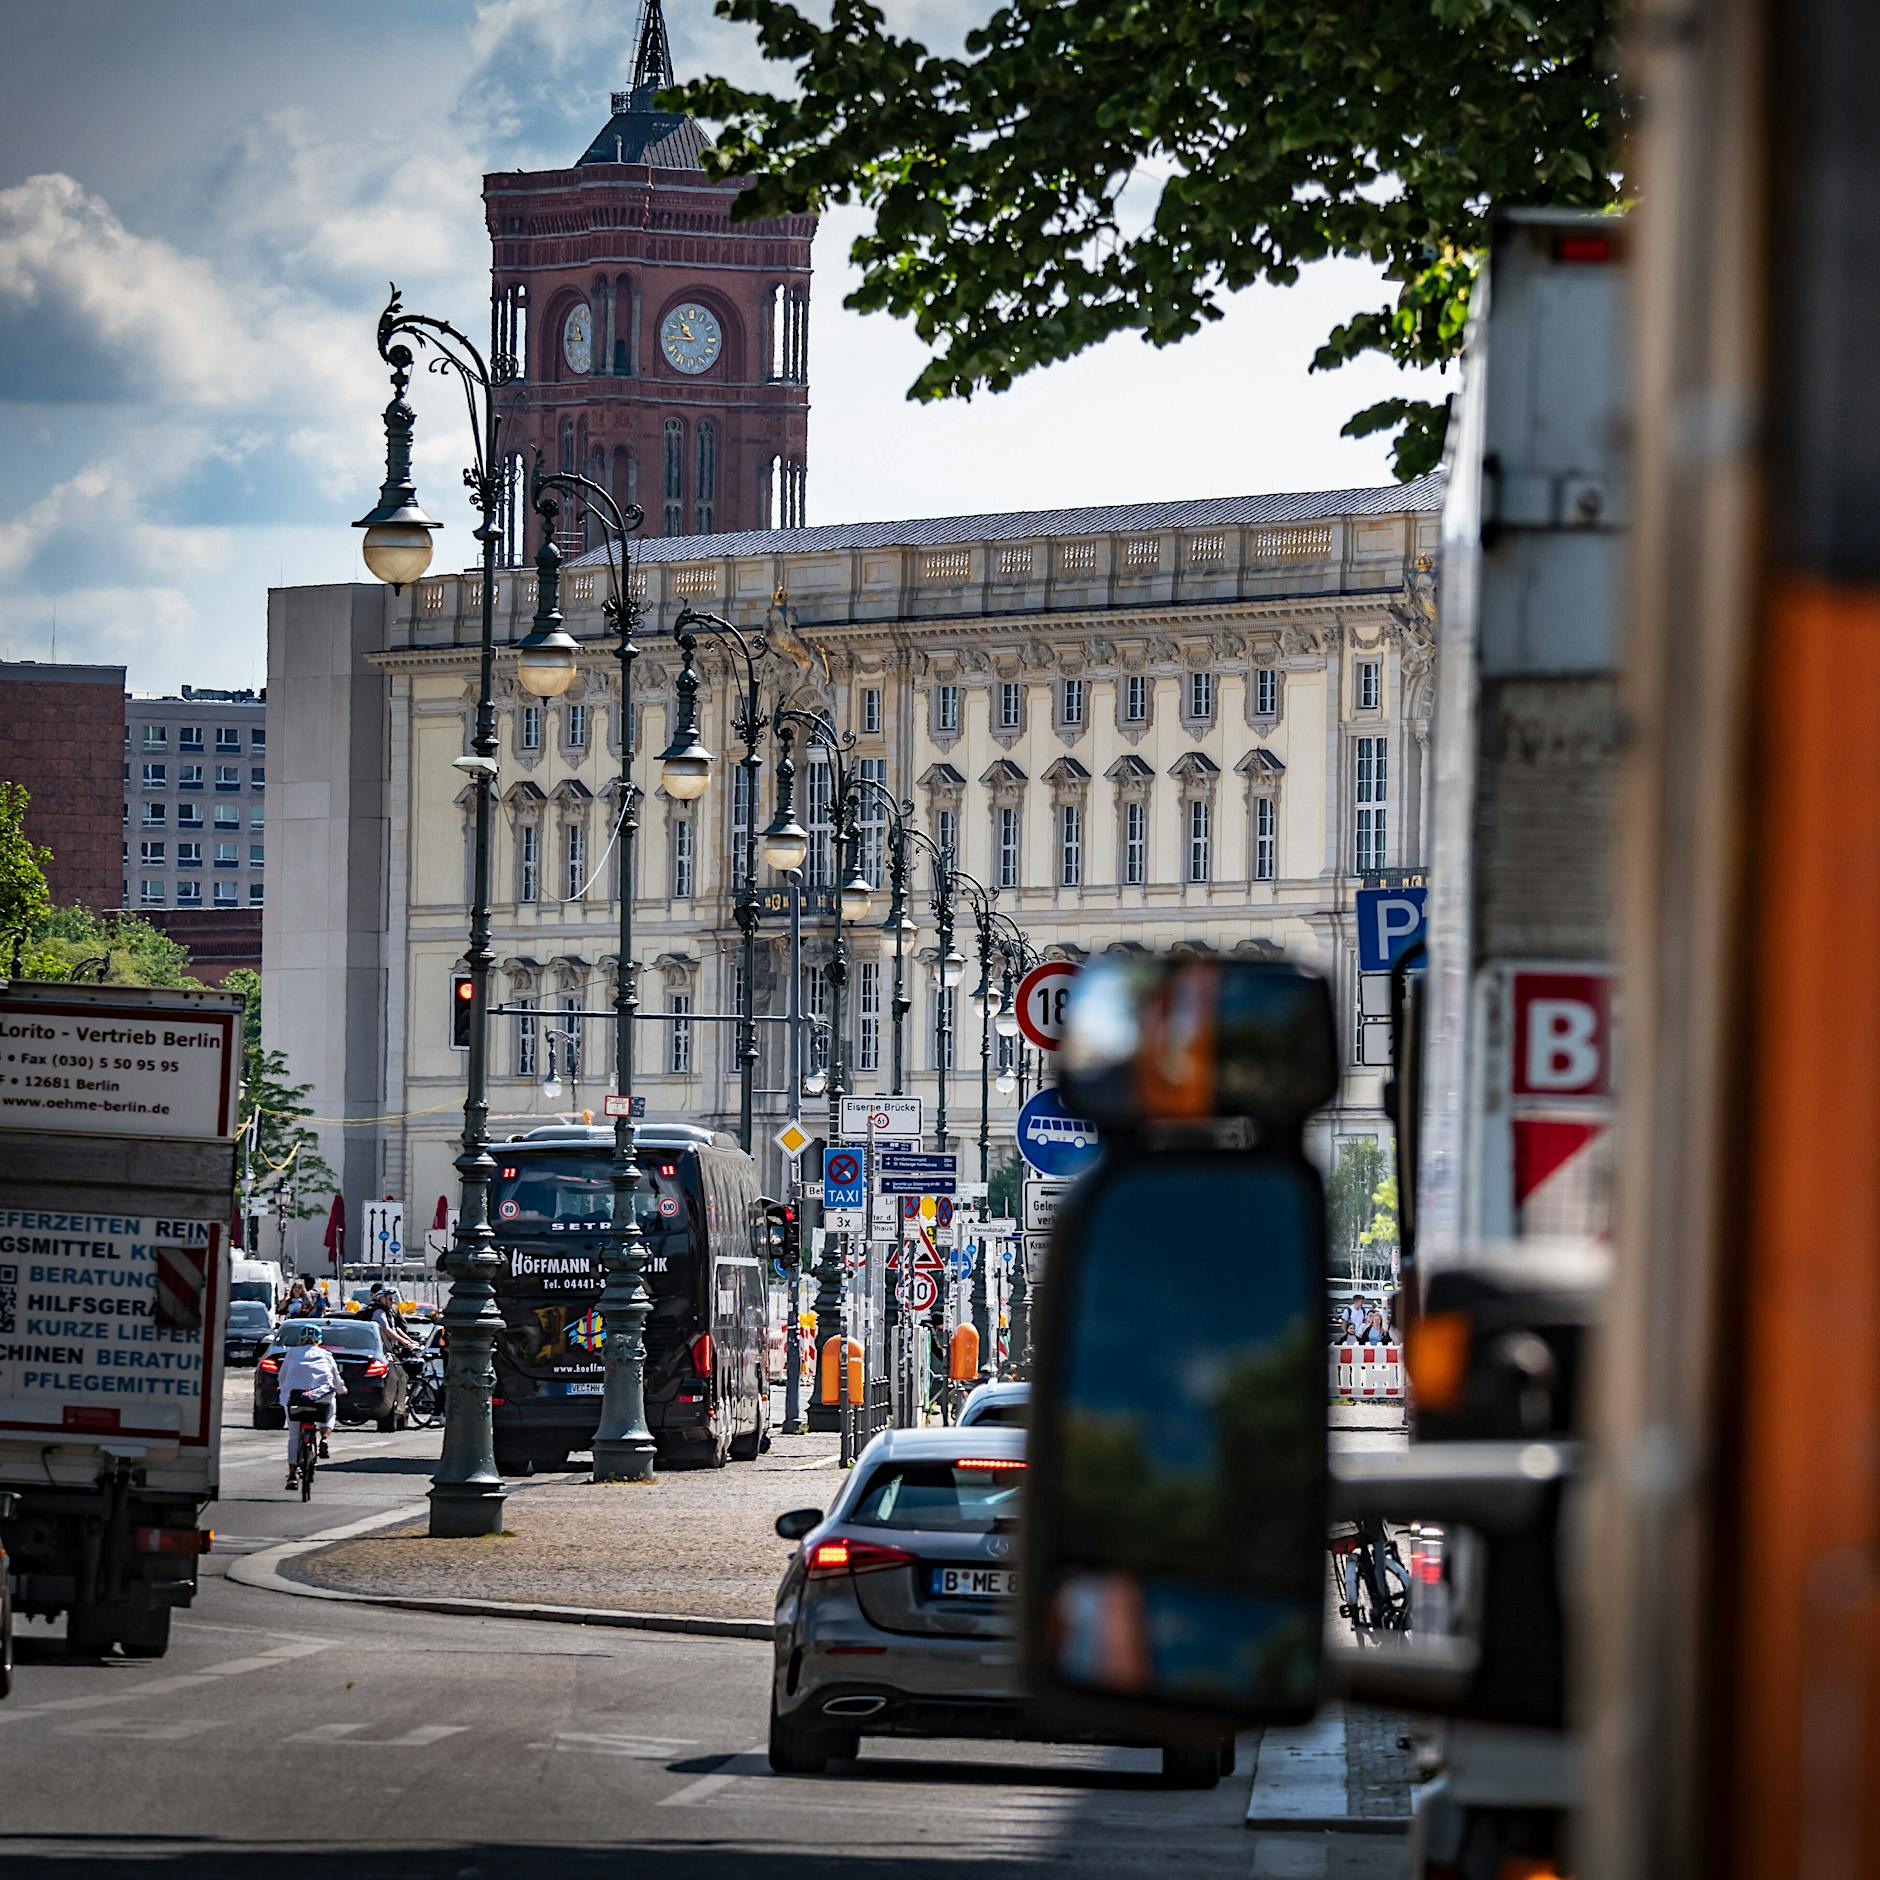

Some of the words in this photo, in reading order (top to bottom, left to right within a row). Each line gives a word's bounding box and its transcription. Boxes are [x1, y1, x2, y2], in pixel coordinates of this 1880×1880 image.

[1376, 899, 1420, 960] P
[1037, 987, 1070, 1025] 18
[0, 1022, 55, 1040] Lorito
[76, 1026, 157, 1045] Vertrieb
[163, 1031, 220, 1049] Berlin
[1526, 999, 1600, 1090] B
[21, 1053, 47, 1065] Fax
[52, 1054, 93, 1070] (030)
[100, 1057, 108, 1068] 5
[113, 1057, 131, 1070] 50
[137, 1059, 155, 1072] 95
[161, 1060, 179, 1073] 95
[25, 1076, 70, 1089] 12681
[76, 1078, 119, 1091] Berlin
[2, 1097, 170, 1115] www.oehme-berlin.de
[884, 1103, 916, 1112] Brücke
[828, 1189, 859, 1203] TAXI
[662, 1203, 674, 1211] 100
[155, 1220, 208, 1239] REIN
[836, 1216, 851, 1228] 3x
[0, 1235, 120, 1260] GSMITTEL
[511, 1247, 590, 1277] HÖFFMANN
[543, 1279, 561, 1290] Tel.
[26, 1319, 109, 1339] KURZE
[117, 1324, 201, 1344] LIEFER
[23, 1371, 200, 1396] PFLEGEMITTEL
[945, 1571, 958, 1591] B
[972, 1571, 1002, 1592] ME
